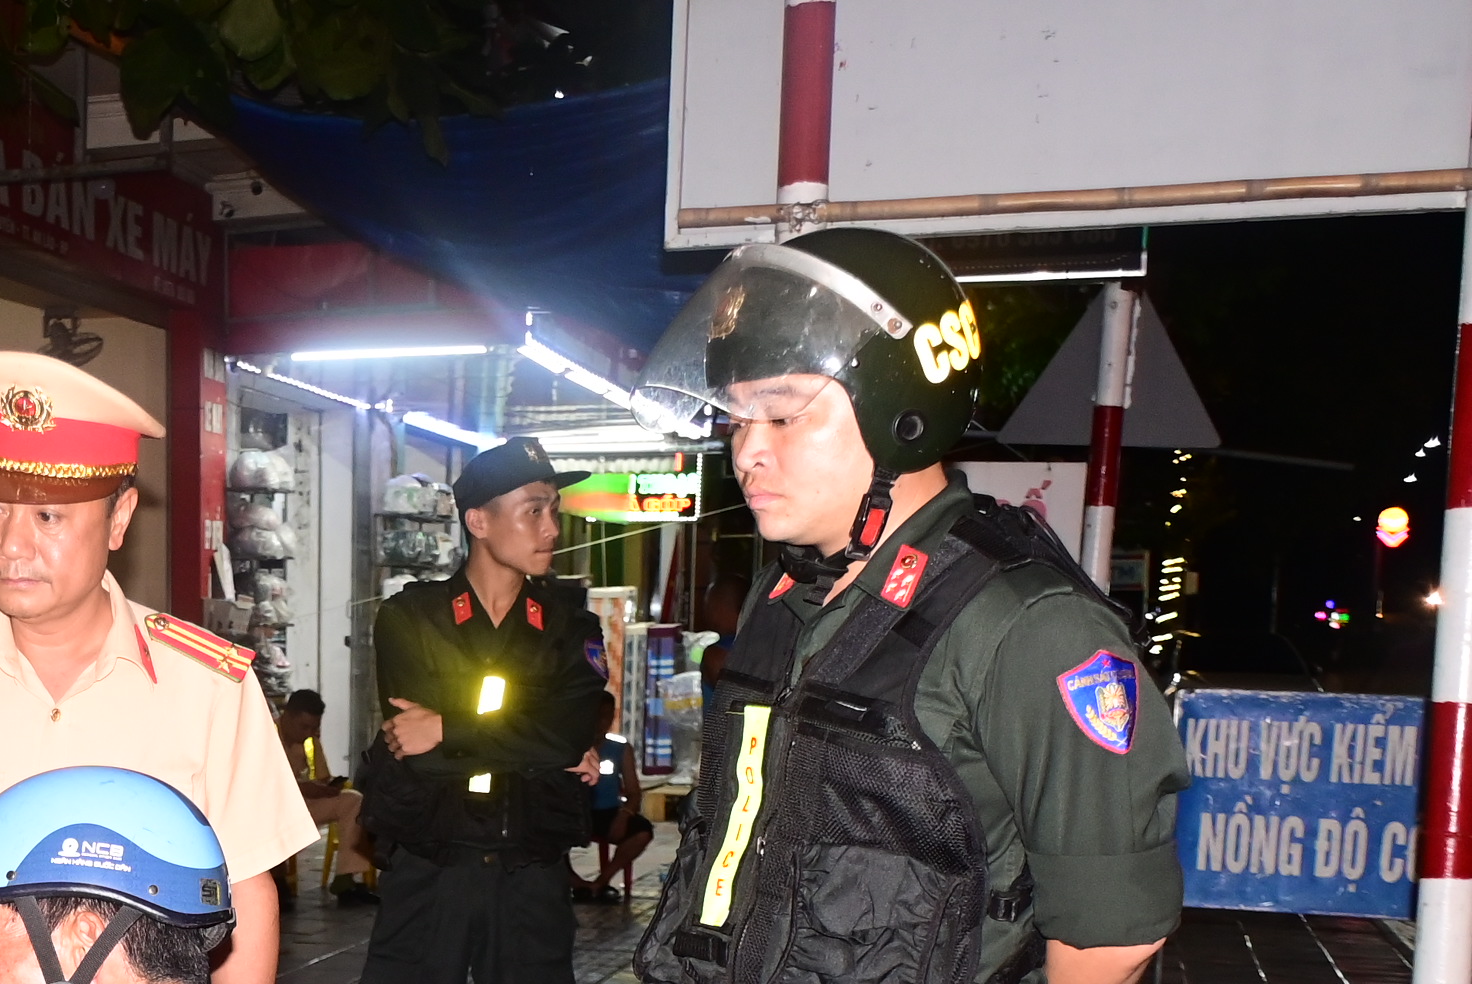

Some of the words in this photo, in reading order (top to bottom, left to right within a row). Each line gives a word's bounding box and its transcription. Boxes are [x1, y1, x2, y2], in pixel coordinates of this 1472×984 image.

[105, 195, 144, 261] XE
[152, 211, 212, 286] MÁY
[1186, 718, 1250, 779] KHU
[1259, 715, 1323, 795] VỰC
[1329, 703, 1419, 787] KIỂM
[82, 840, 124, 857] NCB
[715, 737, 757, 896] POLICE
[1313, 806, 1369, 893] ĐỘ
